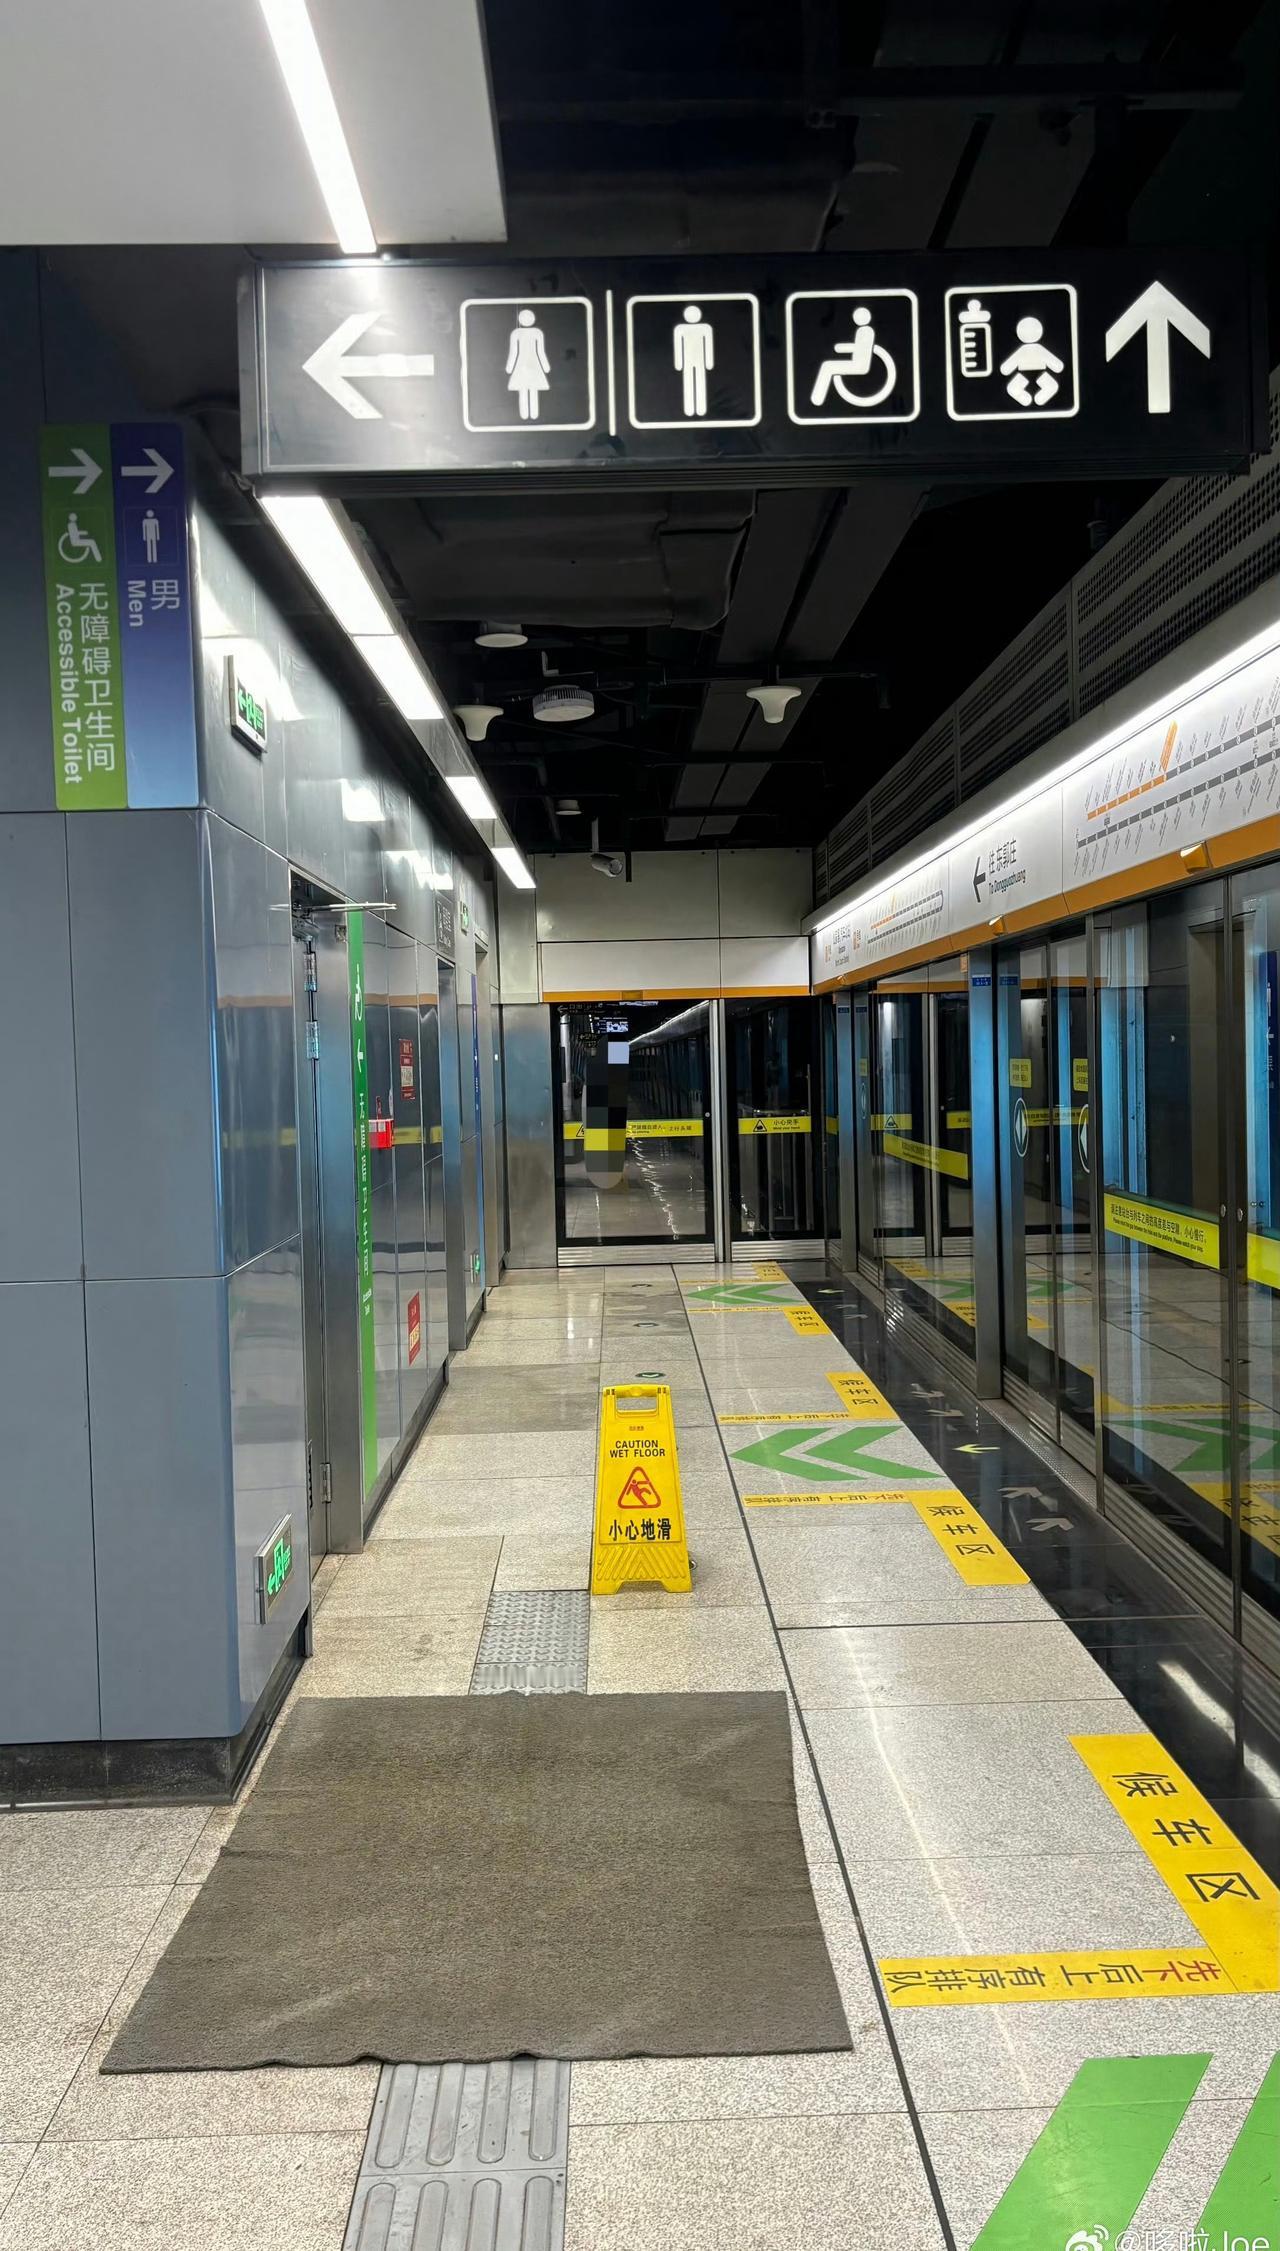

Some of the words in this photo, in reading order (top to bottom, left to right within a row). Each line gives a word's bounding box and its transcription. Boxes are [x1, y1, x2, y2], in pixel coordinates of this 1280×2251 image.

[128, 579, 147, 628] Men
[151, 578, 181, 610] 男
[55, 583, 81, 712] Accessible
[79, 581, 116, 773] 无障碍卫生间
[62, 716, 83, 784] Toilet
[609, 1449, 629, 1458] WET
[633, 1448, 666, 1458] FLOOR
[615, 1439, 659, 1449] CAUTION
[608, 1518, 672, 1541] 小心地滑
[928, 1505, 996, 1556] 候车区
[1112, 1771, 1260, 1902] 候车区
